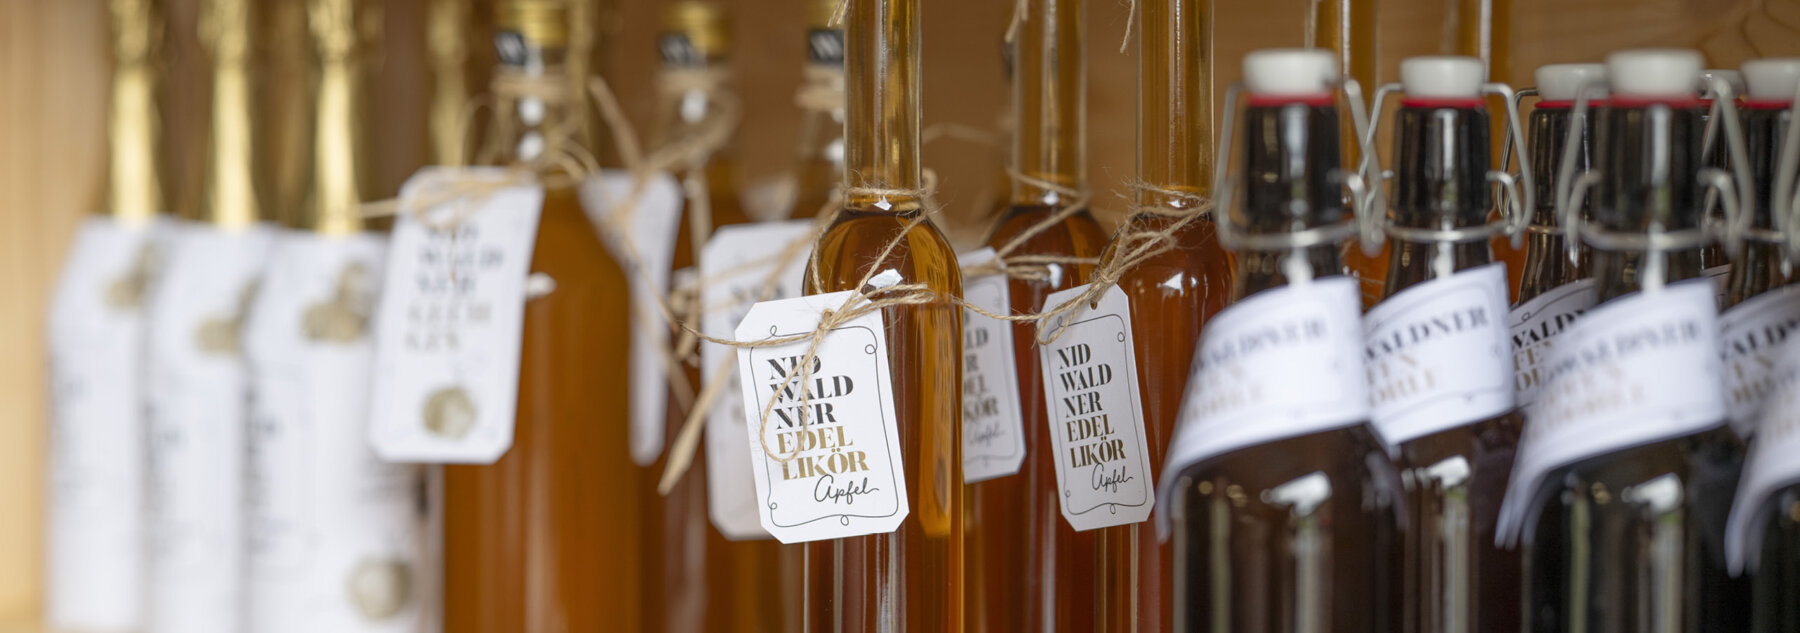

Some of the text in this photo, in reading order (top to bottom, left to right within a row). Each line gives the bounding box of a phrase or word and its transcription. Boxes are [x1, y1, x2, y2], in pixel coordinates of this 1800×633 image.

[767, 355, 822, 380] NID
[1057, 342, 1091, 370] NID
[770, 375, 854, 404] WALD
[1060, 363, 1112, 393] WALD
[774, 402, 837, 430] NER
[1063, 391, 1103, 418] NER
[776, 425, 854, 455] EDEL
[1066, 414, 1115, 442] EDEL
[781, 446, 870, 481] LIKÖR
[1070, 436, 1127, 469] LIKÖR
[814, 474, 880, 504] Apfel
[1092, 462, 1134, 493] Apfel
